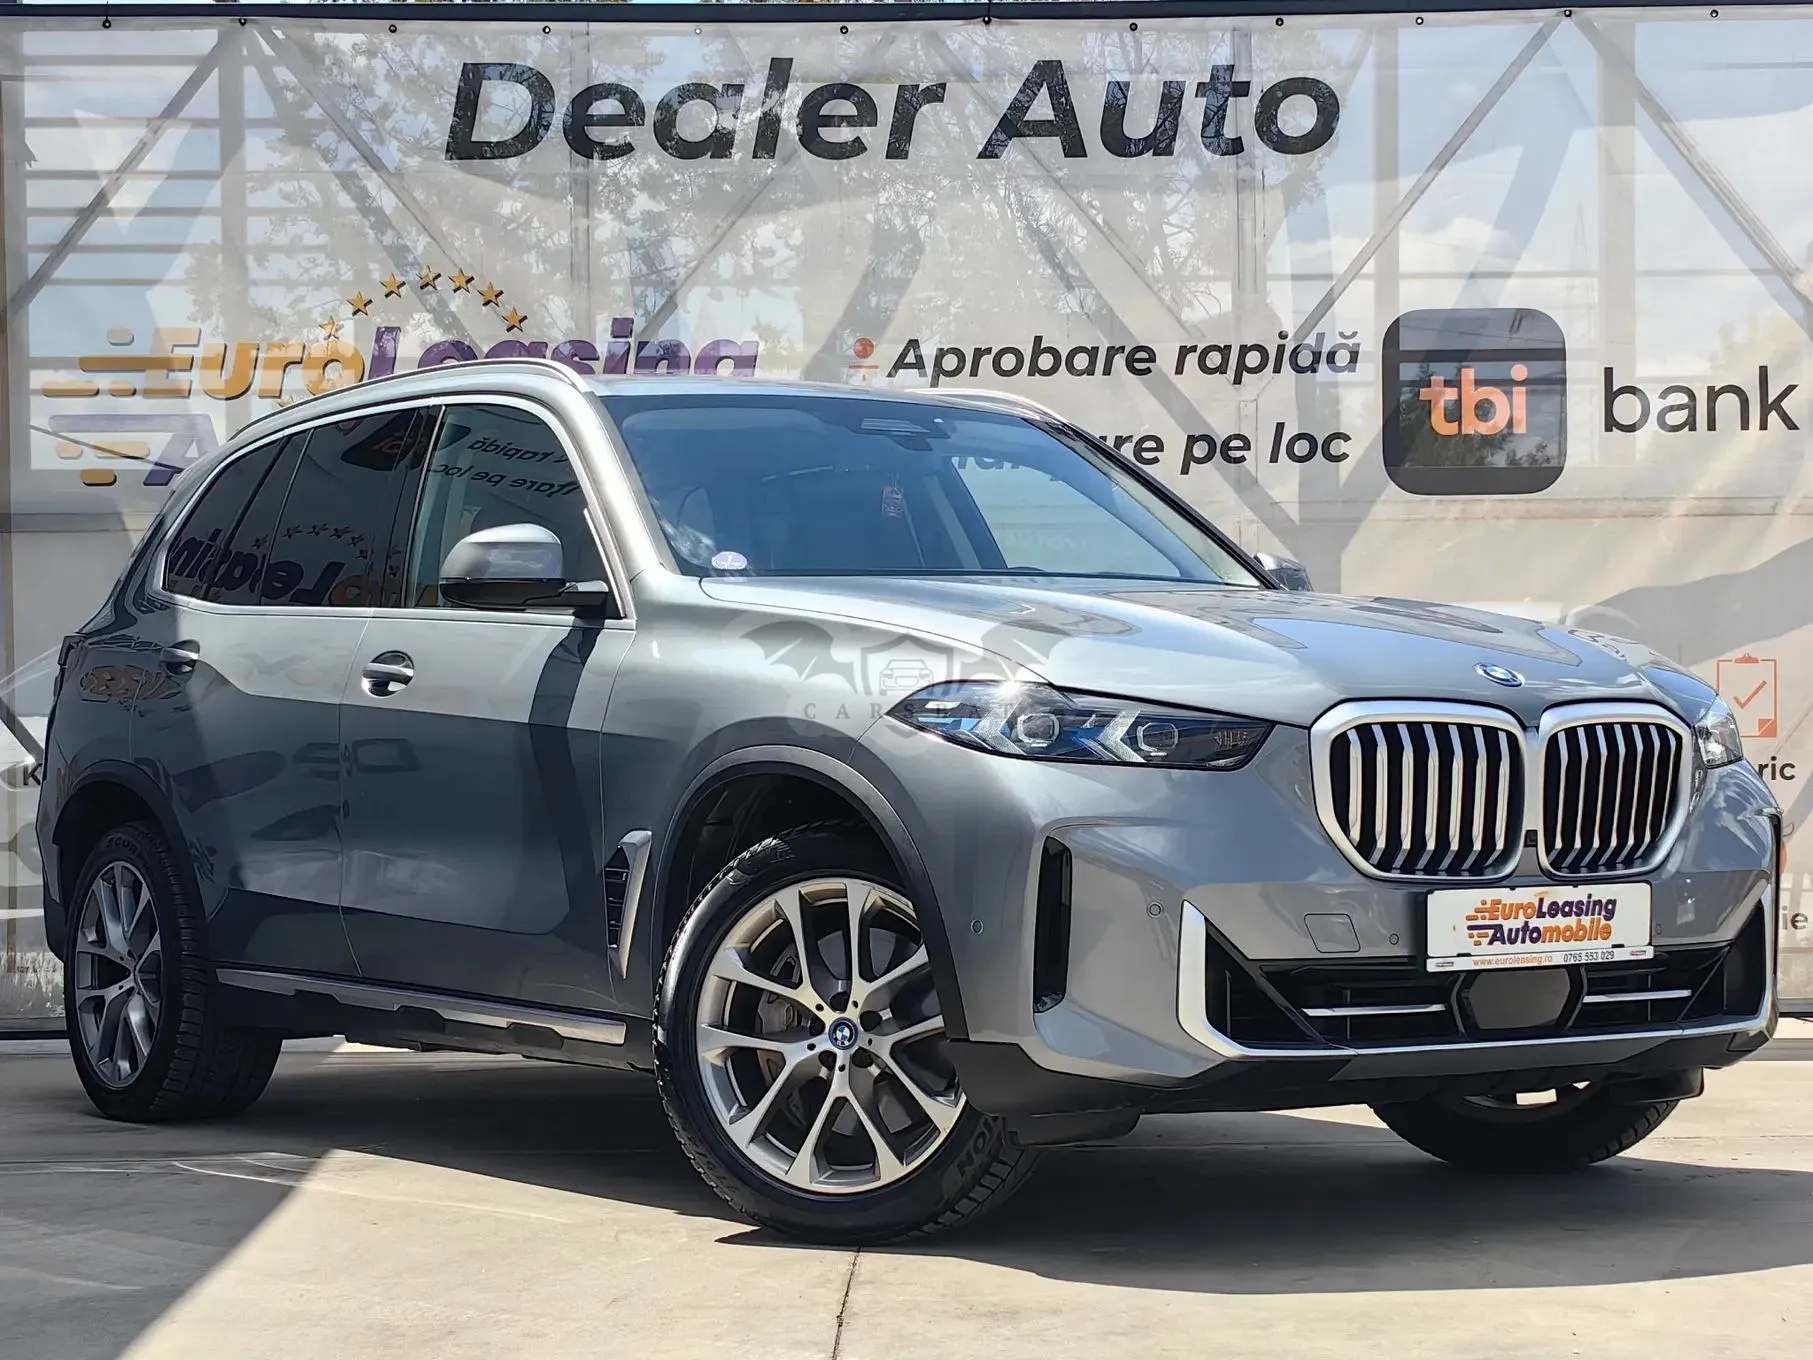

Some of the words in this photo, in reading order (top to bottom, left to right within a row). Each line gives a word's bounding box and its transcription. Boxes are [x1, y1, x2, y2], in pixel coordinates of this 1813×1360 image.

[445, 57, 947, 161] Dealer
[976, 58, 1341, 160] Auto
[885, 335, 1157, 389] Aprobare
[1174, 330, 1361, 386] rapidă
[1418, 363, 1529, 438] tbi
[1604, 365, 1800, 433] bank
[1180, 431, 1252, 475] pe
[1269, 422, 1352, 464] loc
[1467, 917, 1612, 946] Automobile
[1474, 893, 1617, 921] EuroLeasing
[1473, 953, 1553, 967] www.euroleasing.ro
[1563, 952, 1582, 963] 0765
[1584, 951, 1599, 962] 553
[1600, 950, 1615, 961] 029
